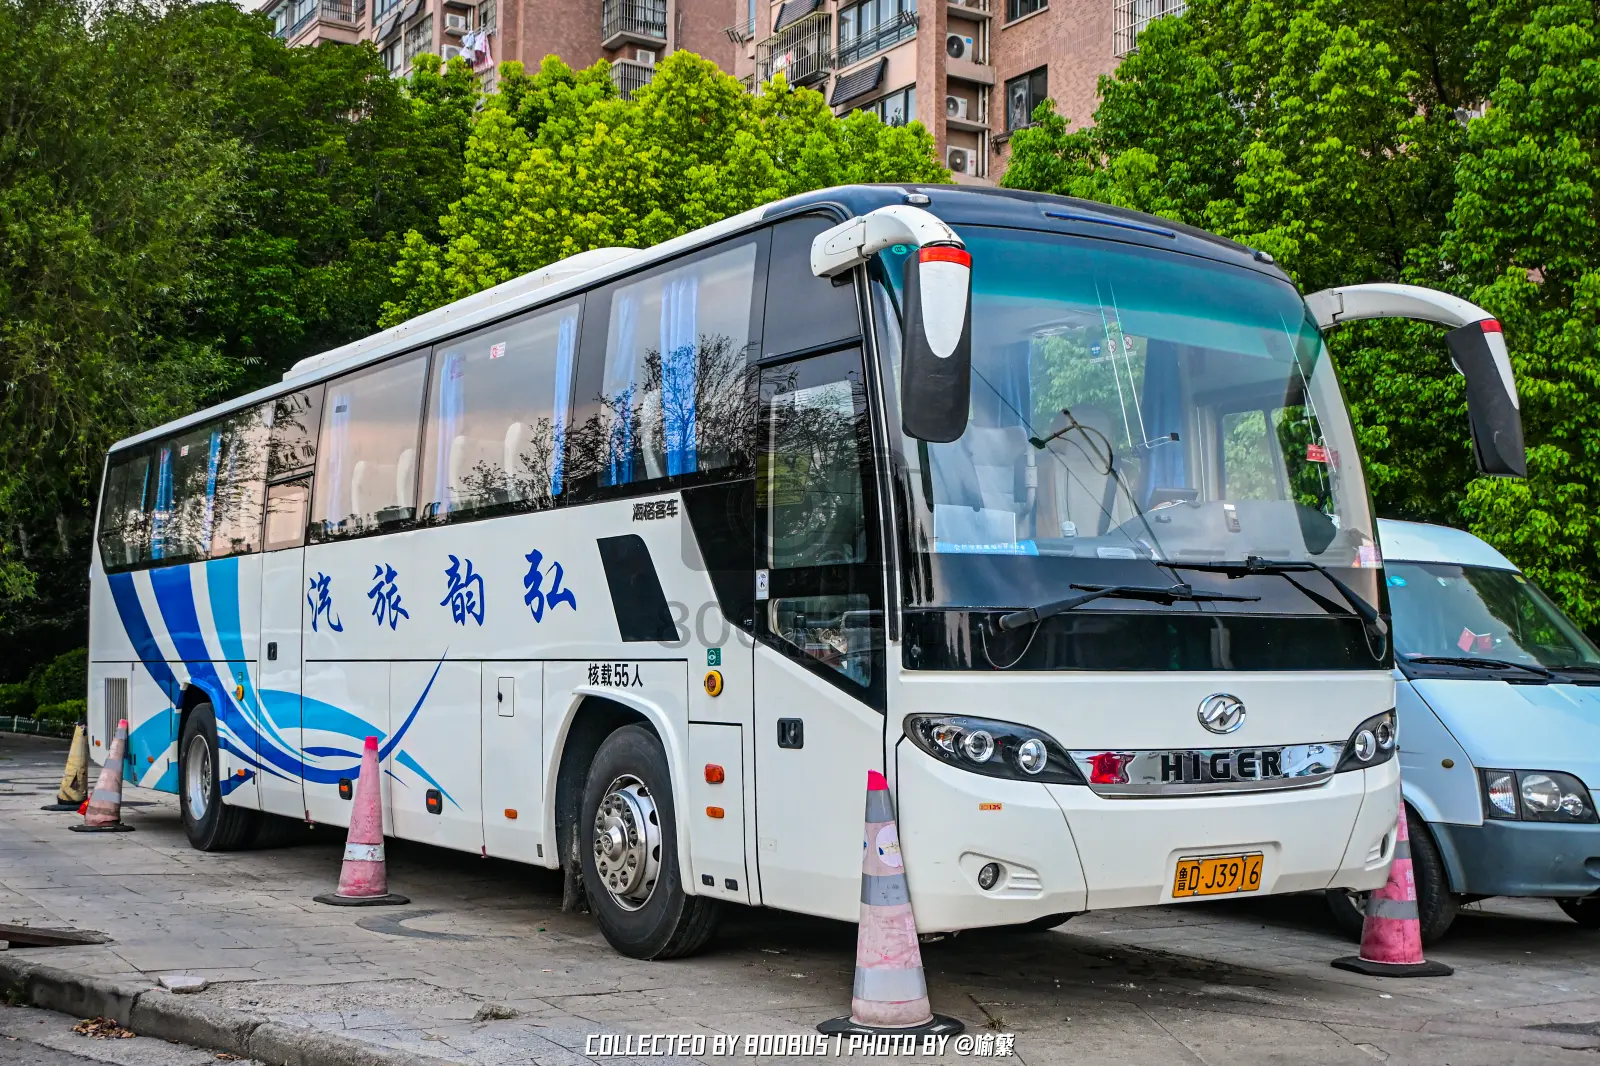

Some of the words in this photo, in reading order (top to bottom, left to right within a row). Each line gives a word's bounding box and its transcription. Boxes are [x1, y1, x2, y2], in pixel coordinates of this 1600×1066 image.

[632, 498, 678, 522] 海格客车
[588, 663, 643, 688] 核载55人
[1161, 751, 1282, 781] HIGER
